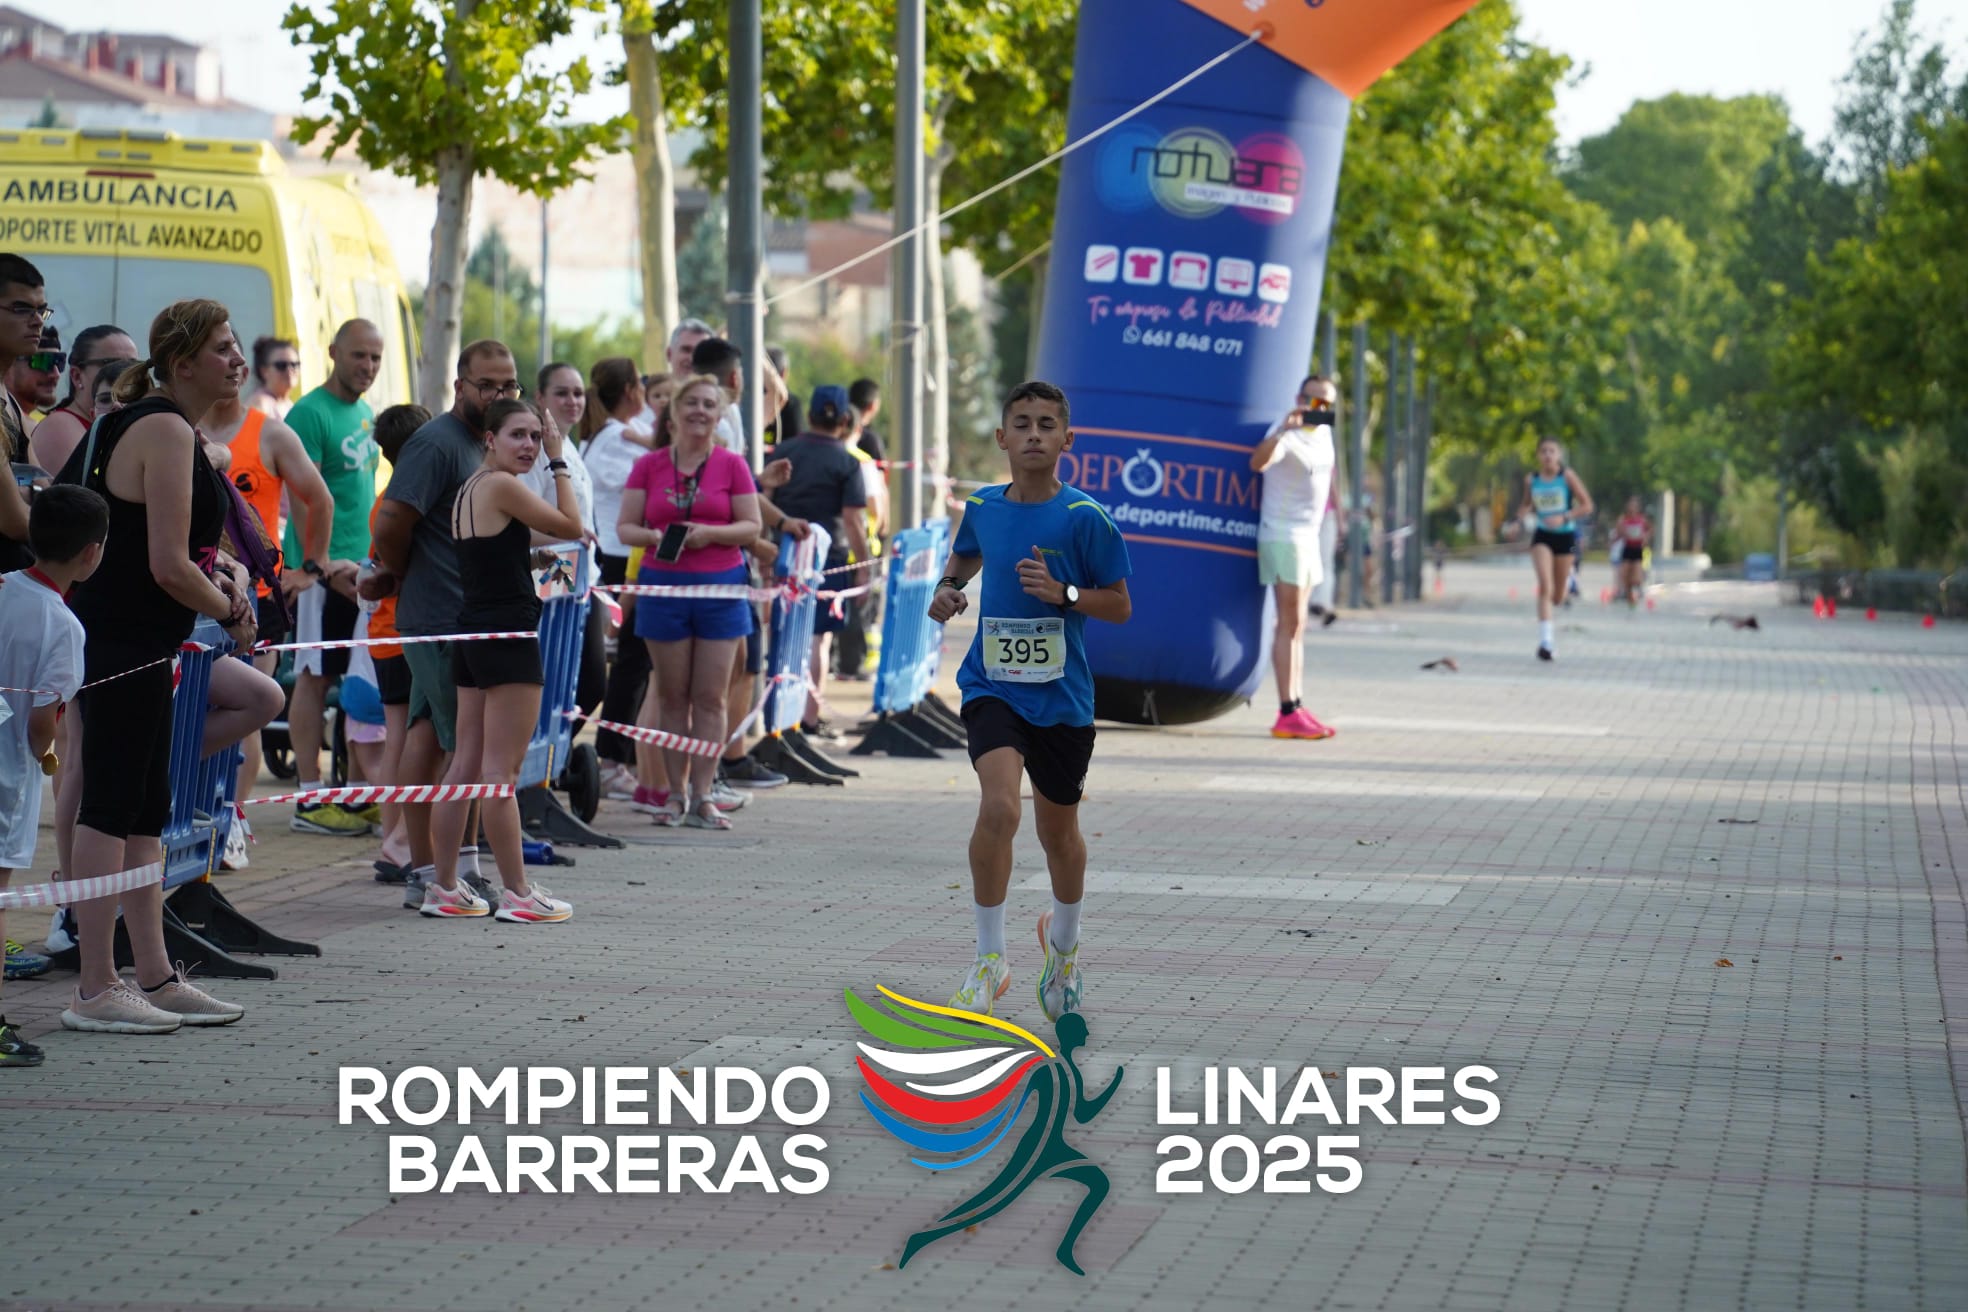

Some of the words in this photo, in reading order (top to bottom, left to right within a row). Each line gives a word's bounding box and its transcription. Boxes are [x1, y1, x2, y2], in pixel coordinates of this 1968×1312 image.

[3, 180, 238, 212] AMBULANCIA
[84, 221, 141, 247] VITAL
[147, 225, 263, 254] AVANZADO
[1142, 329, 1172, 347] 661
[1213, 338, 1243, 356] 071
[1054, 448, 1258, 510] DEPORTIM
[998, 638, 1050, 664] 395
